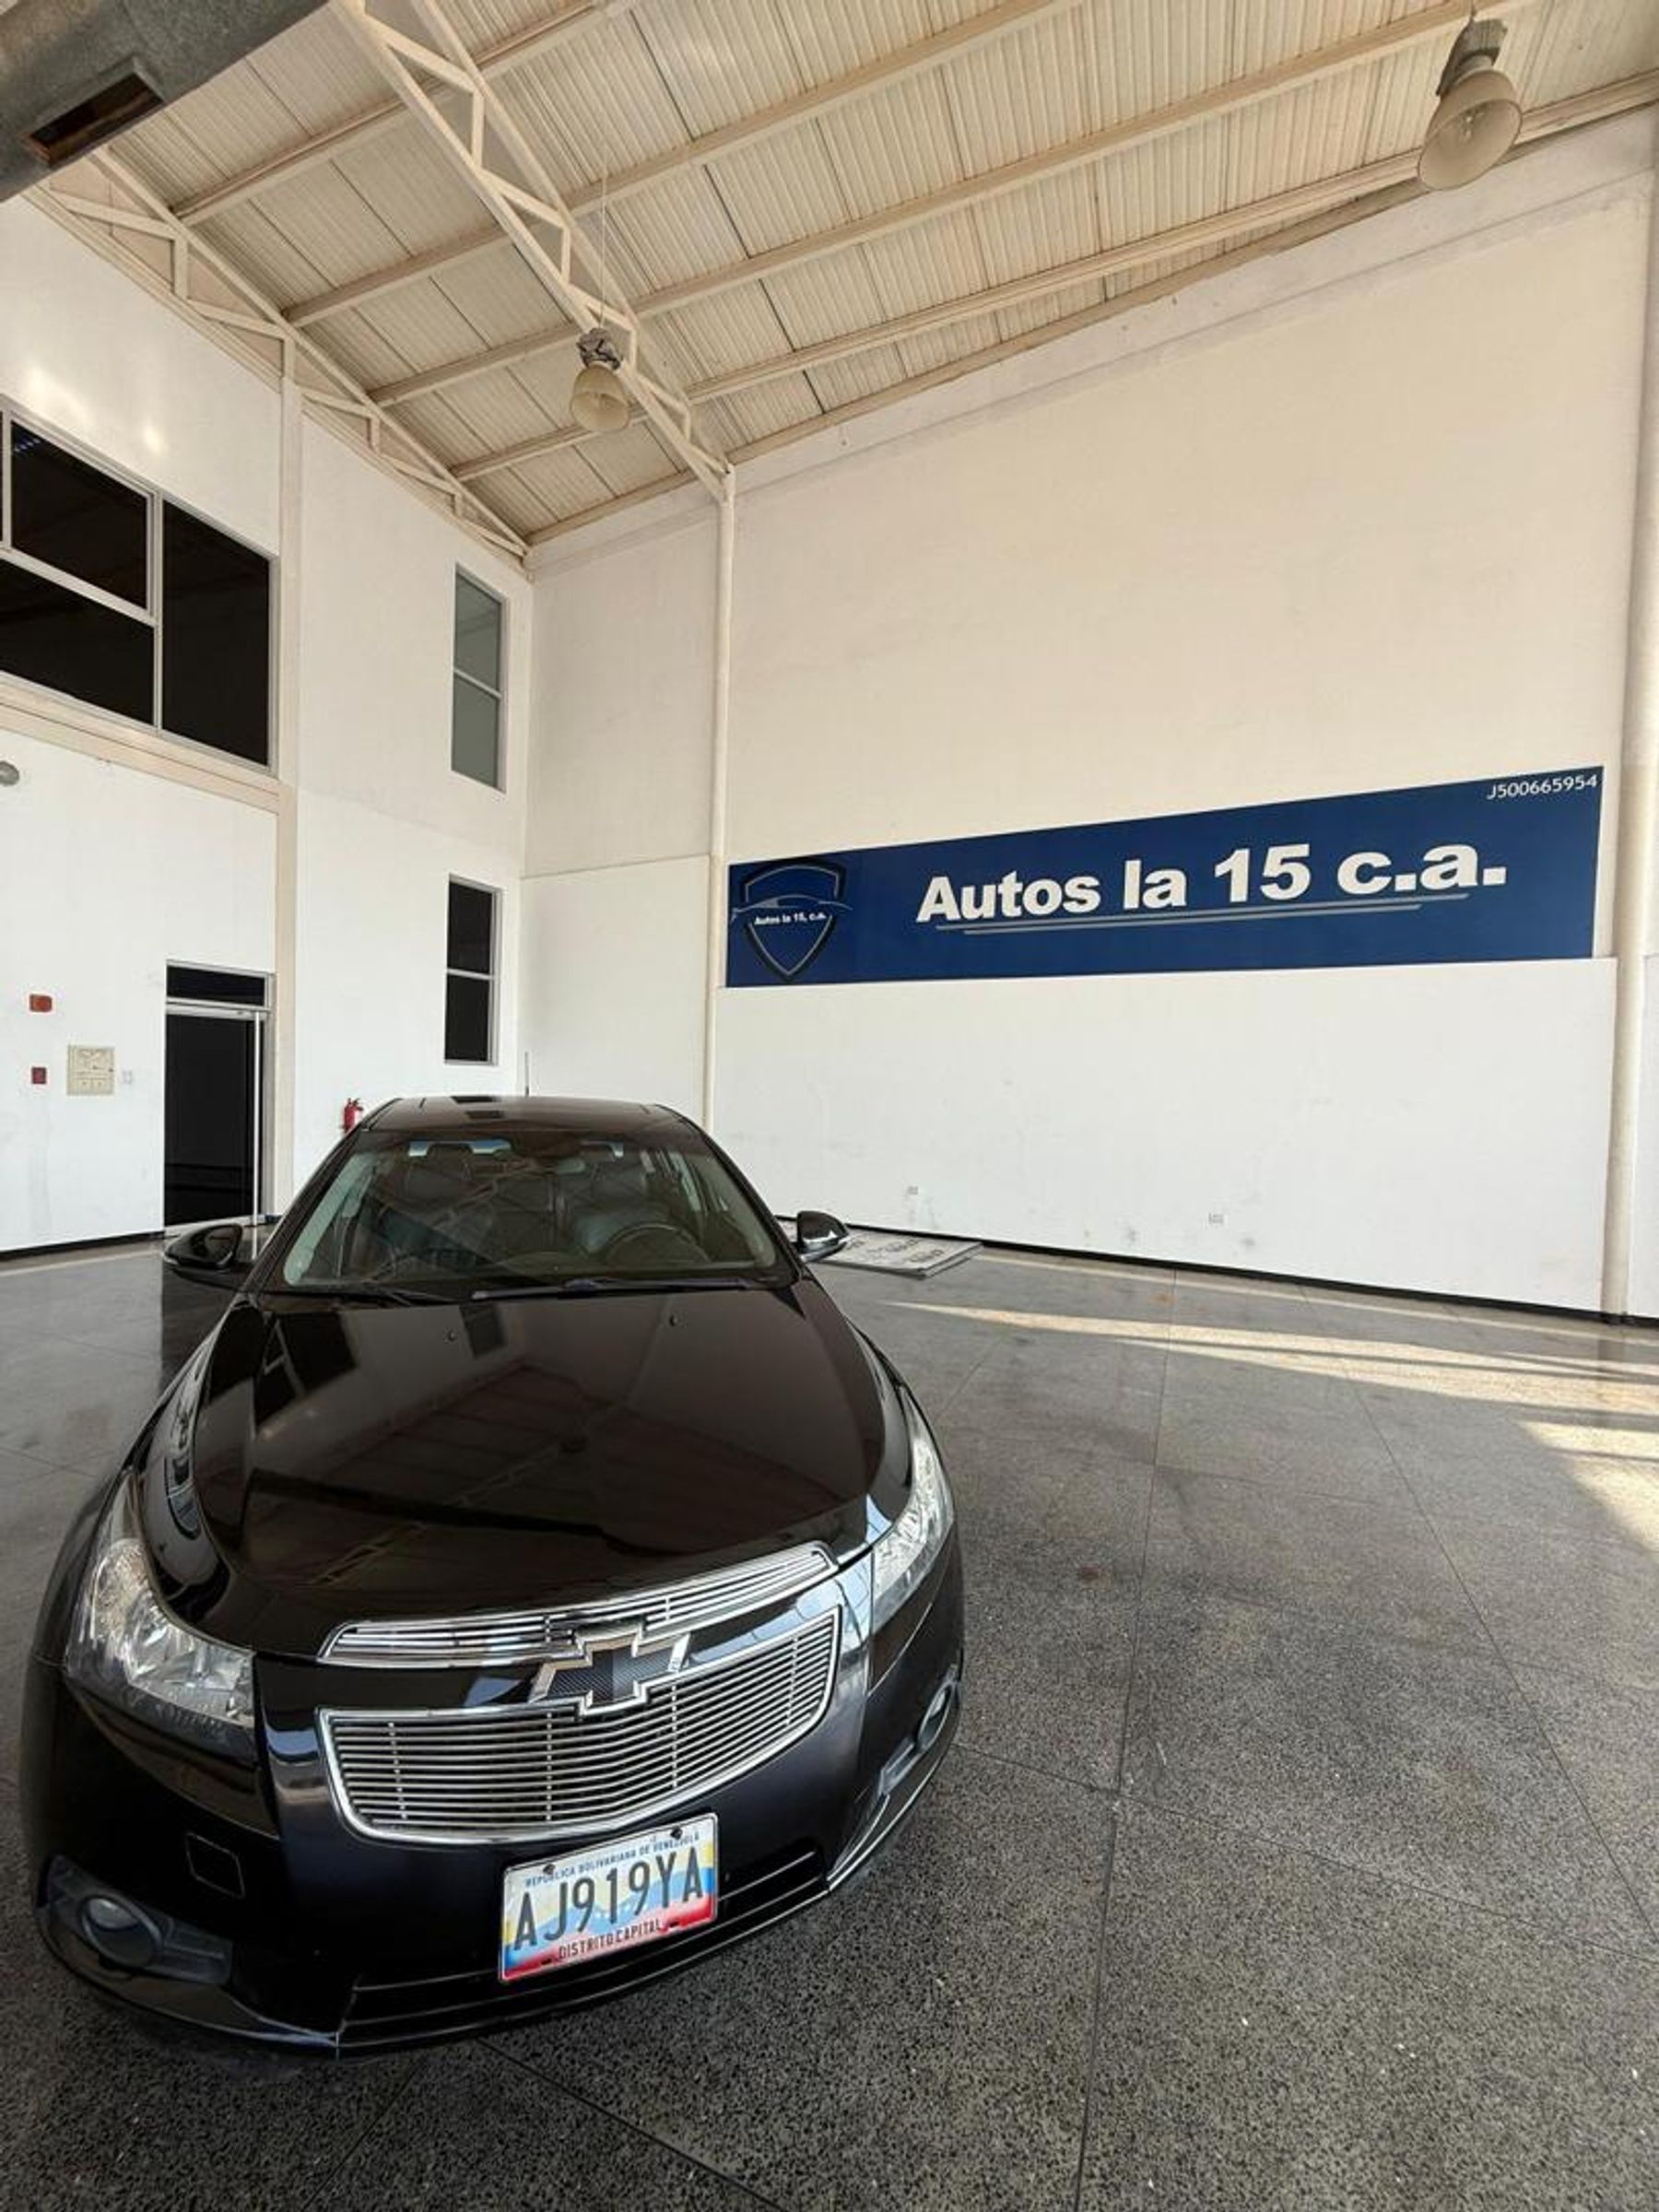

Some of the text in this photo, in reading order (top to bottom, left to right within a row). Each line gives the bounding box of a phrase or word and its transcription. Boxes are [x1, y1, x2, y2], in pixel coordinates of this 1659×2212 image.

[1486, 773, 1598, 800] J500665954
[916, 841, 1507, 923] Autos la 15 c.a.
[754, 915, 781, 925] Autos
[782, 912, 792, 924] la
[578, 1849, 637, 1873] BOLIVARIANA
[639, 1844, 651, 1856] DE
[653, 1832, 700, 1853] VENEZUELA
[513, 1845, 703, 1951] AJ919YA
[559, 1919, 662, 1959] DISTRITO CAPITAL
